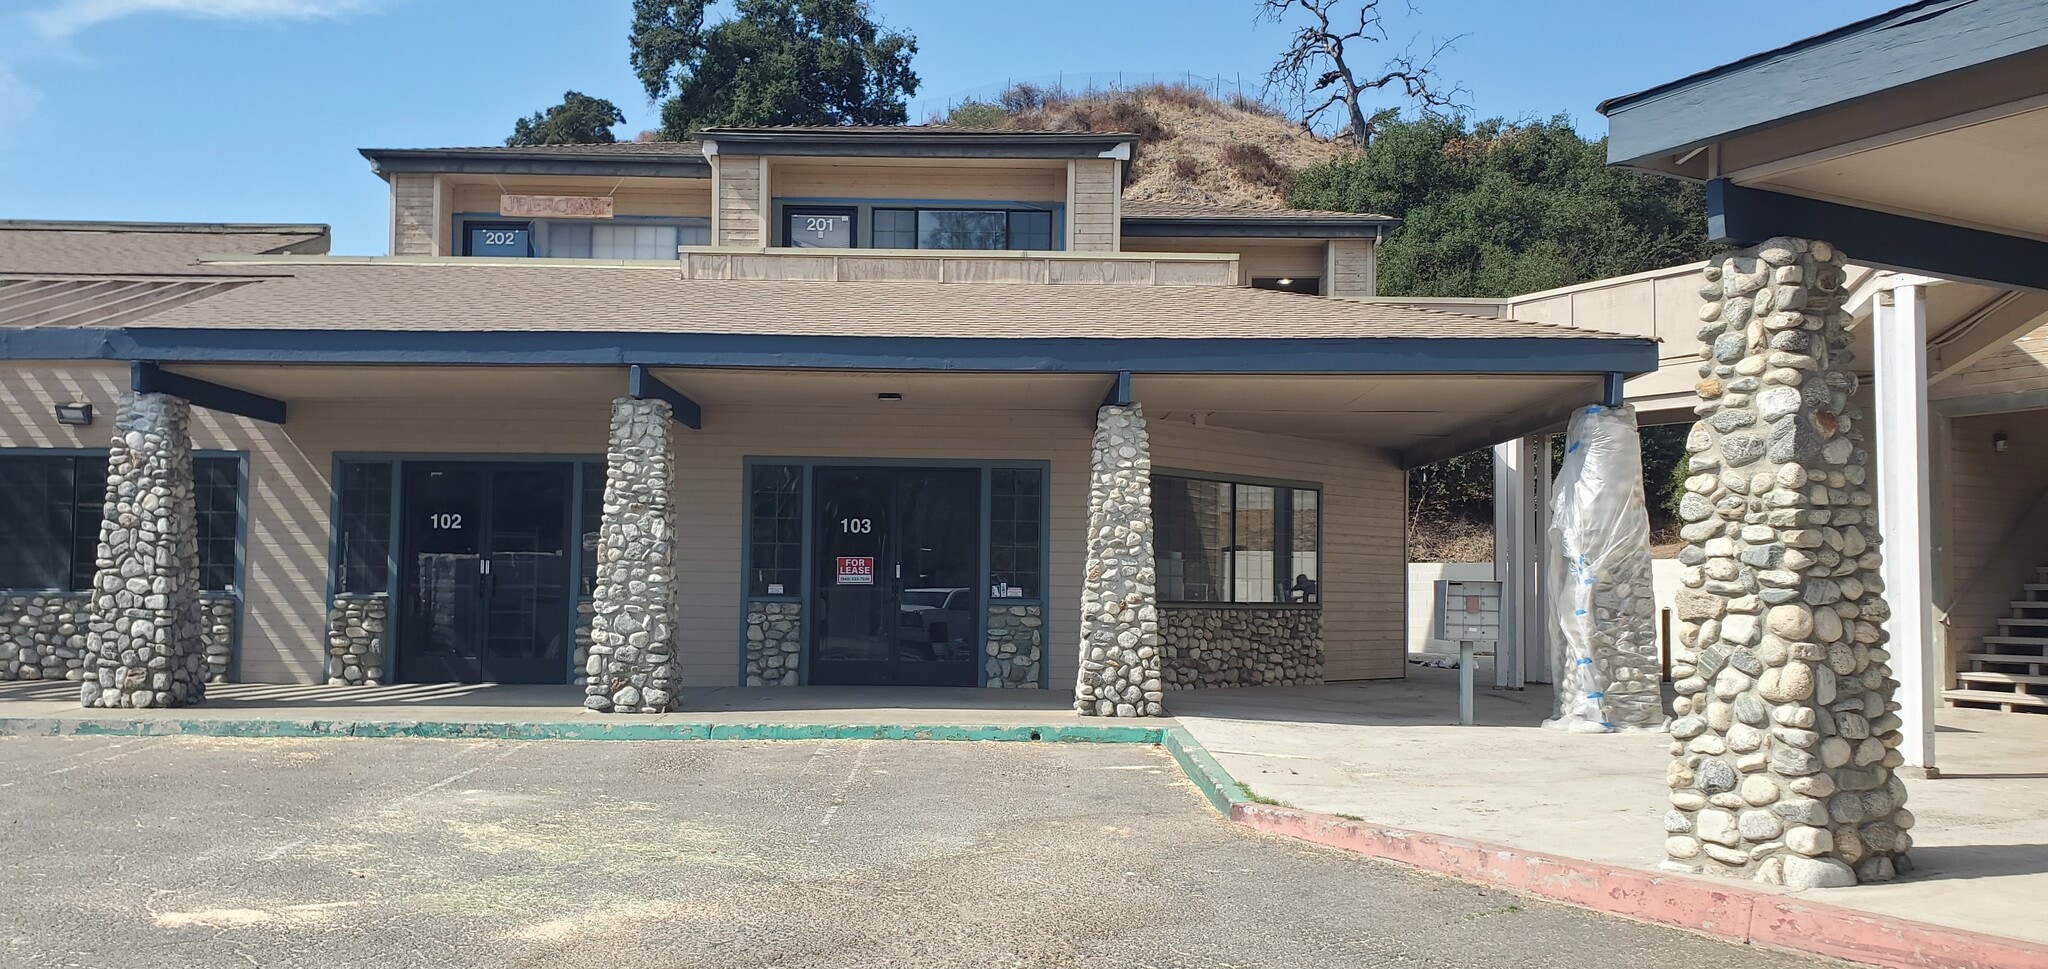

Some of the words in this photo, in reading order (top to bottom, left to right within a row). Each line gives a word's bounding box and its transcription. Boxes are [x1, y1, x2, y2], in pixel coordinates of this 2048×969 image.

[806, 218, 833, 231] 201
[485, 232, 515, 245] 202
[430, 513, 462, 529] 102
[840, 518, 872, 533] 103
[840, 566, 871, 574] LEASE
